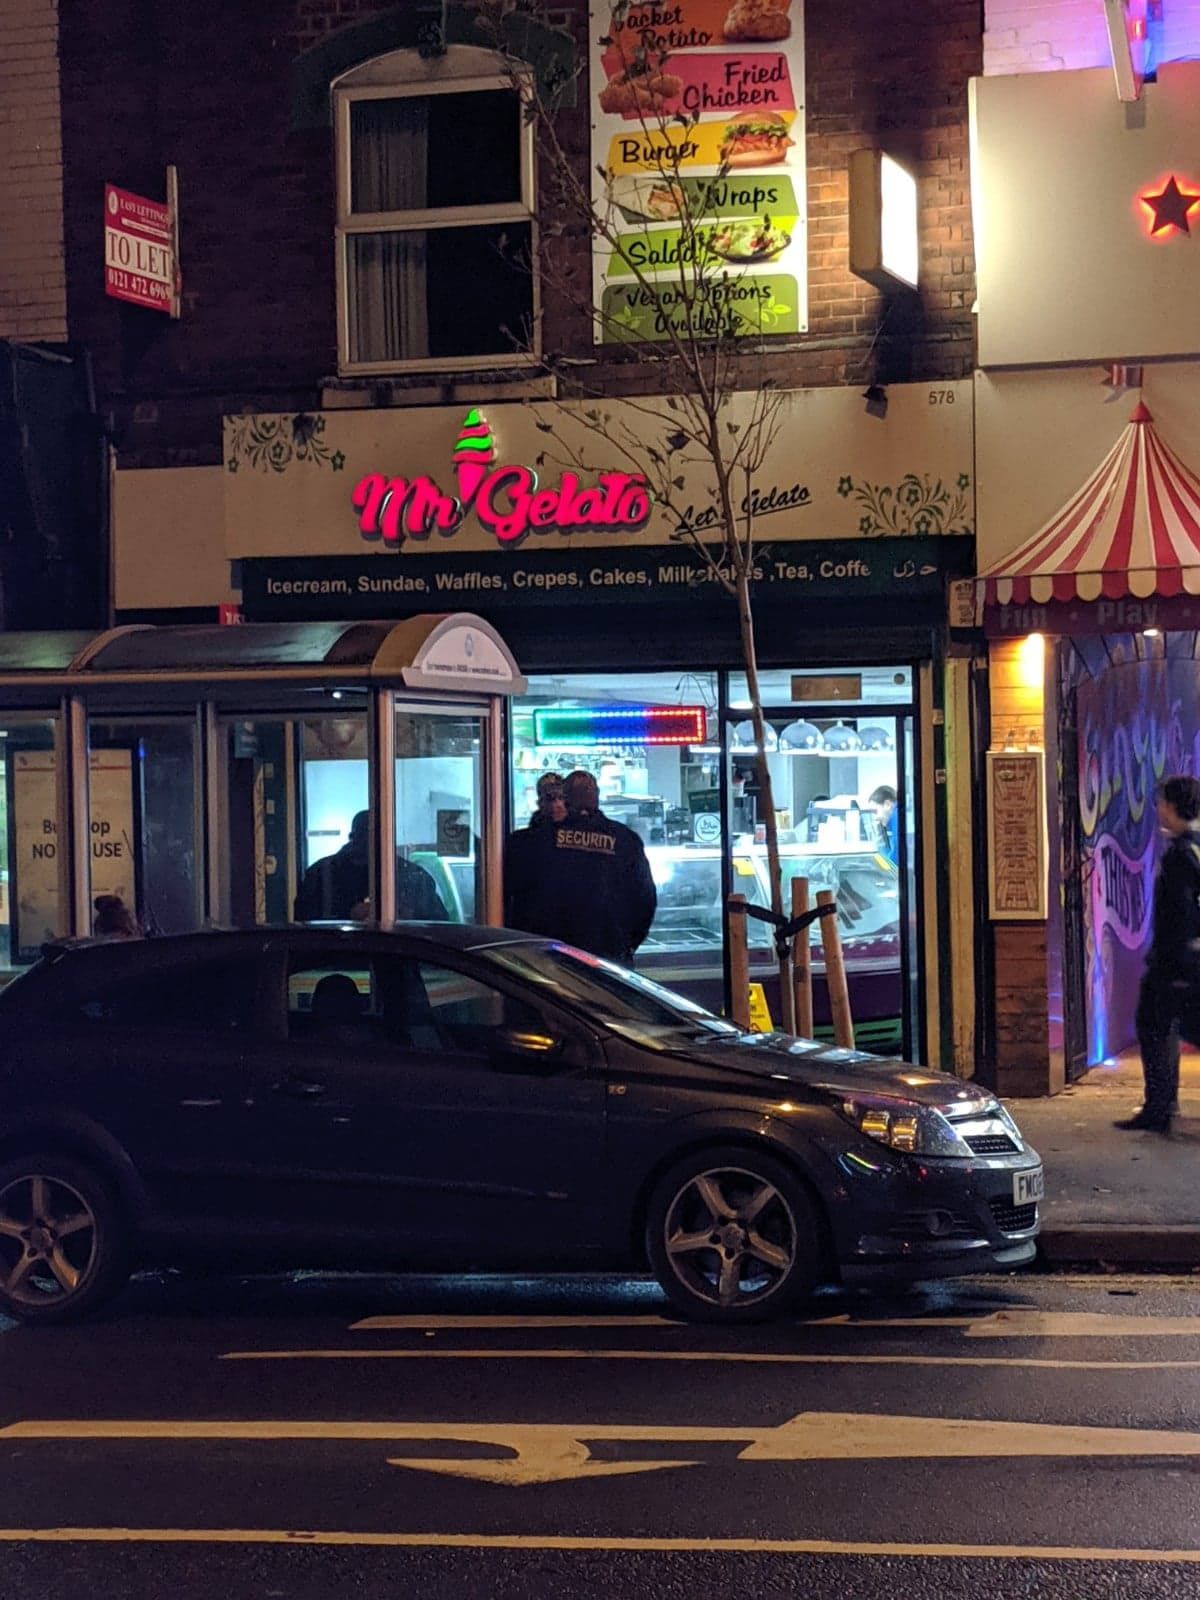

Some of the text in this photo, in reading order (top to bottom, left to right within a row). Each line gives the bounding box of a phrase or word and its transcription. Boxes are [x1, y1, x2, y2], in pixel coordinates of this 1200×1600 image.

[724, 57, 785, 86] Fried
[683, 82, 779, 110] Chicken
[619, 139, 700, 168] Burger
[706, 181, 778, 213] Wraps
[108, 231, 171, 277] TO LET
[351, 465, 649, 544] Mr Gelato
[741, 483, 811, 515] Gelato
[267, 577, 352, 596] Icecream,
[357, 575, 431, 595] Sundae,
[435, 571, 508, 592] Waffles,
[512, 568, 584, 591] Crepes,
[589, 567, 652, 588] Cakes,
[1098, 601, 1159, 626] Play
[93, 842, 123, 858] USE
[556, 828, 617, 851] SECURITY
